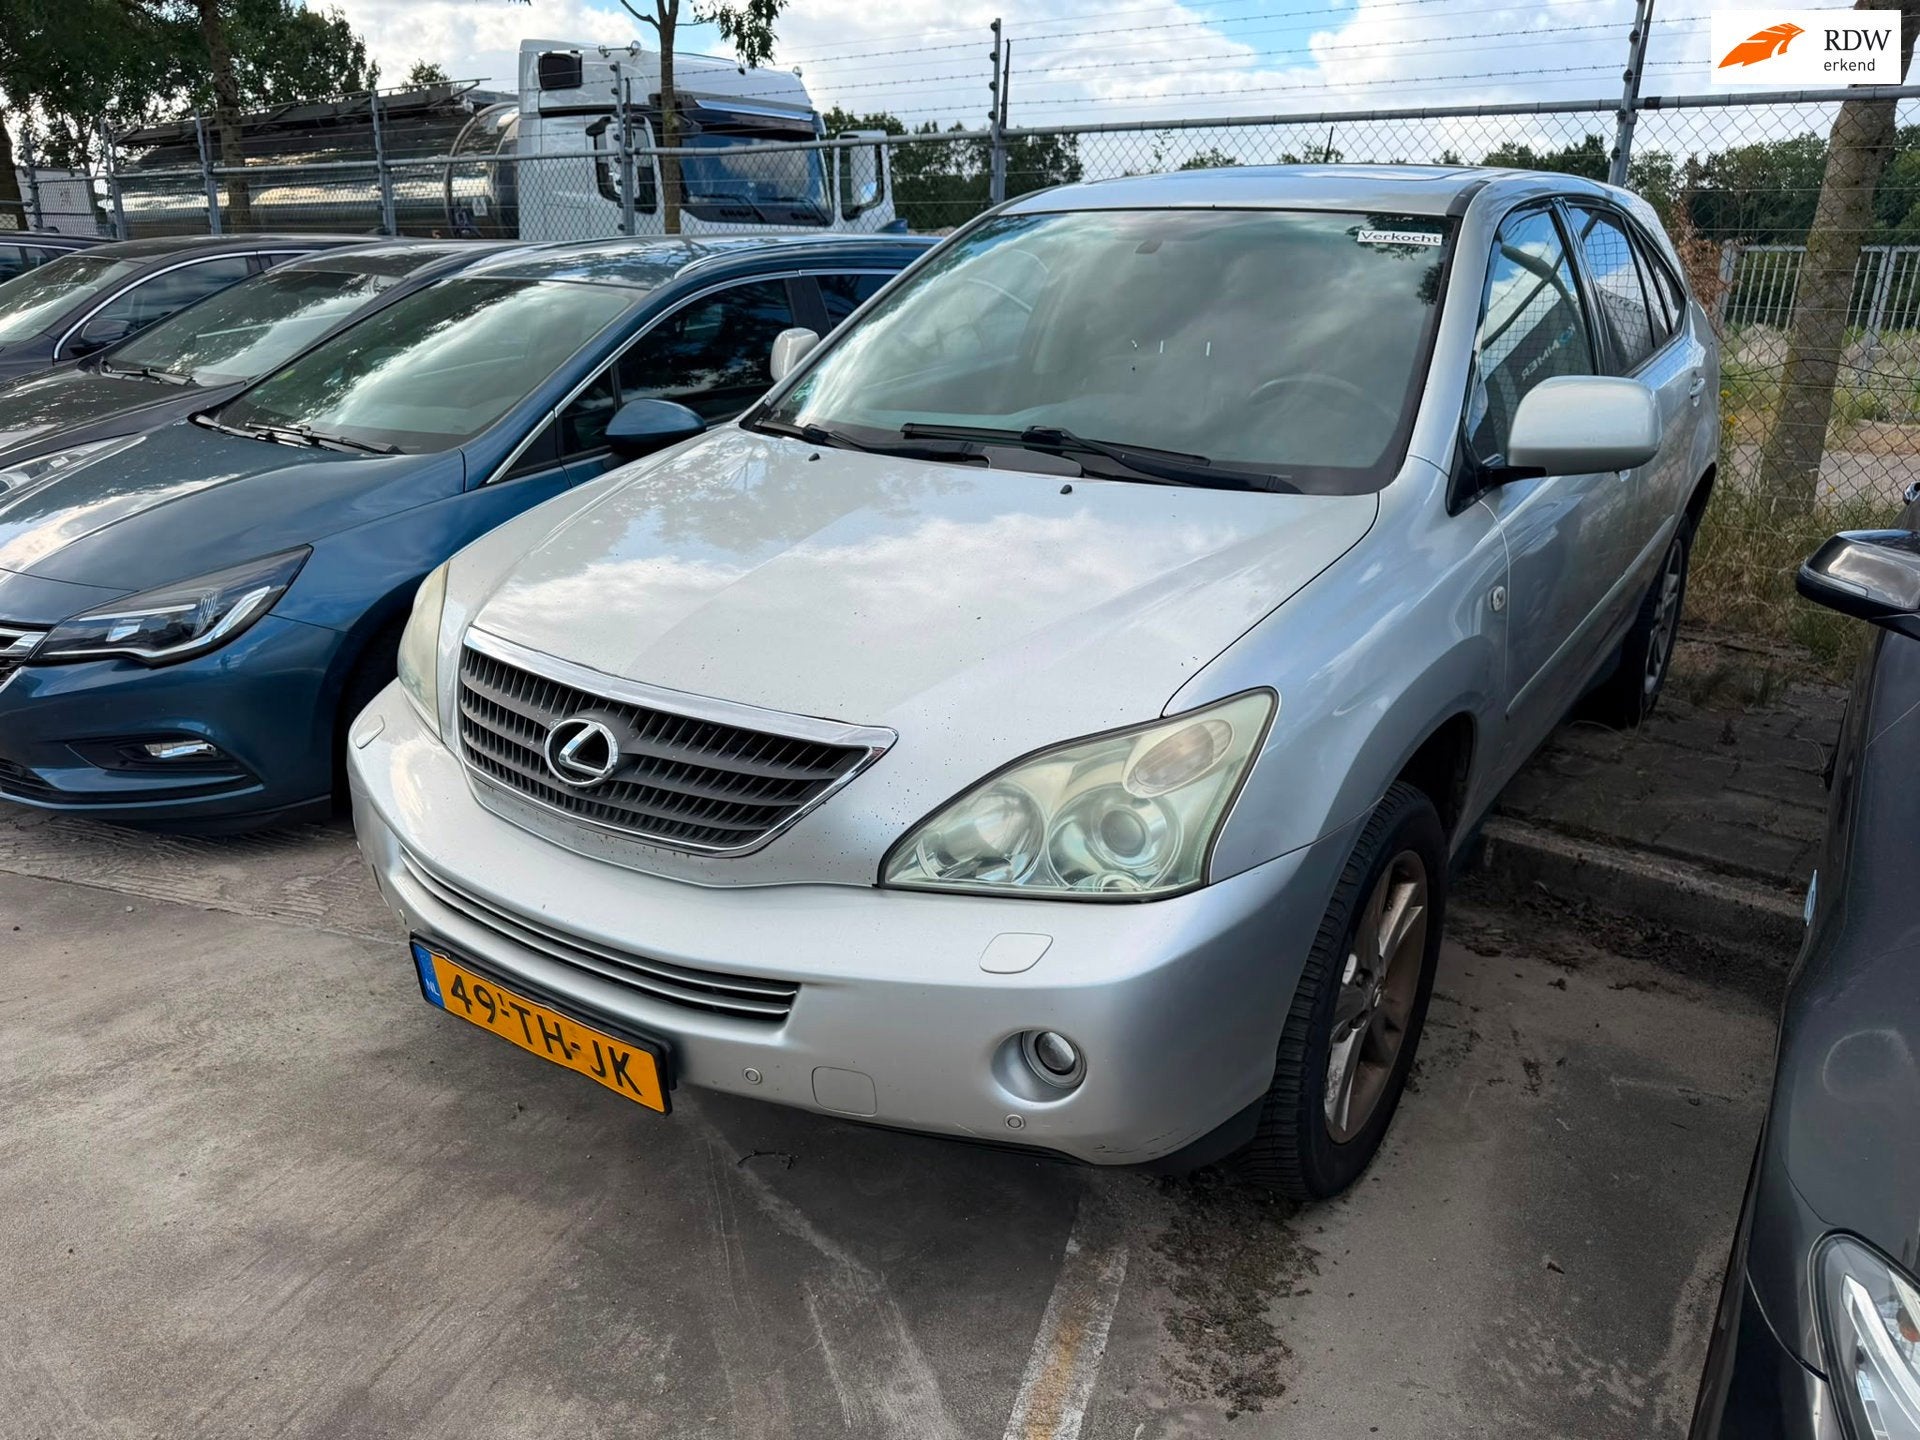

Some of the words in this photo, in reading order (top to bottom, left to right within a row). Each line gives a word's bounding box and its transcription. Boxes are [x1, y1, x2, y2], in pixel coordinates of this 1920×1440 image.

[1361, 231, 1440, 244] Verkocht
[425, 978, 441, 997] NL
[450, 973, 644, 1097] 49-TH-JK
